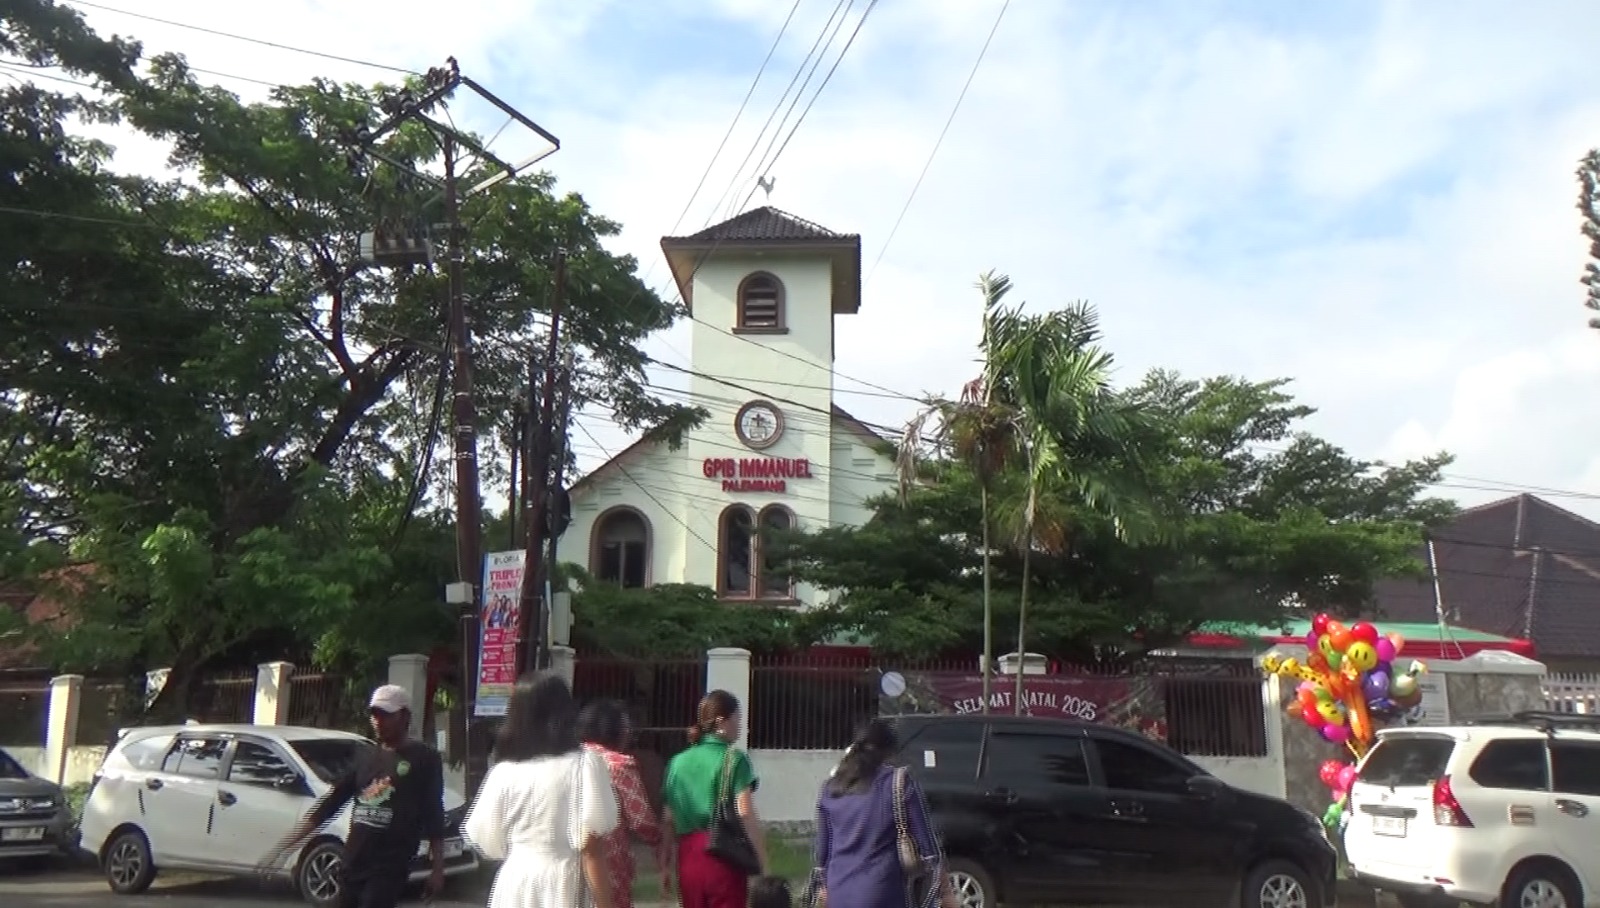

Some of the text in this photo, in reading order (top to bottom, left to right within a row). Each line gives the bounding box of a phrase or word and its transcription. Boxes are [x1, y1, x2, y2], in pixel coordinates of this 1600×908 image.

[703, 458, 812, 478] GPIB IMMANUEL
[722, 480, 786, 493] PALEMBANG
[490, 568, 521, 580] TRIPLE
[1020, 689, 1058, 709] NATAL
[1061, 695, 1098, 721] 2025
